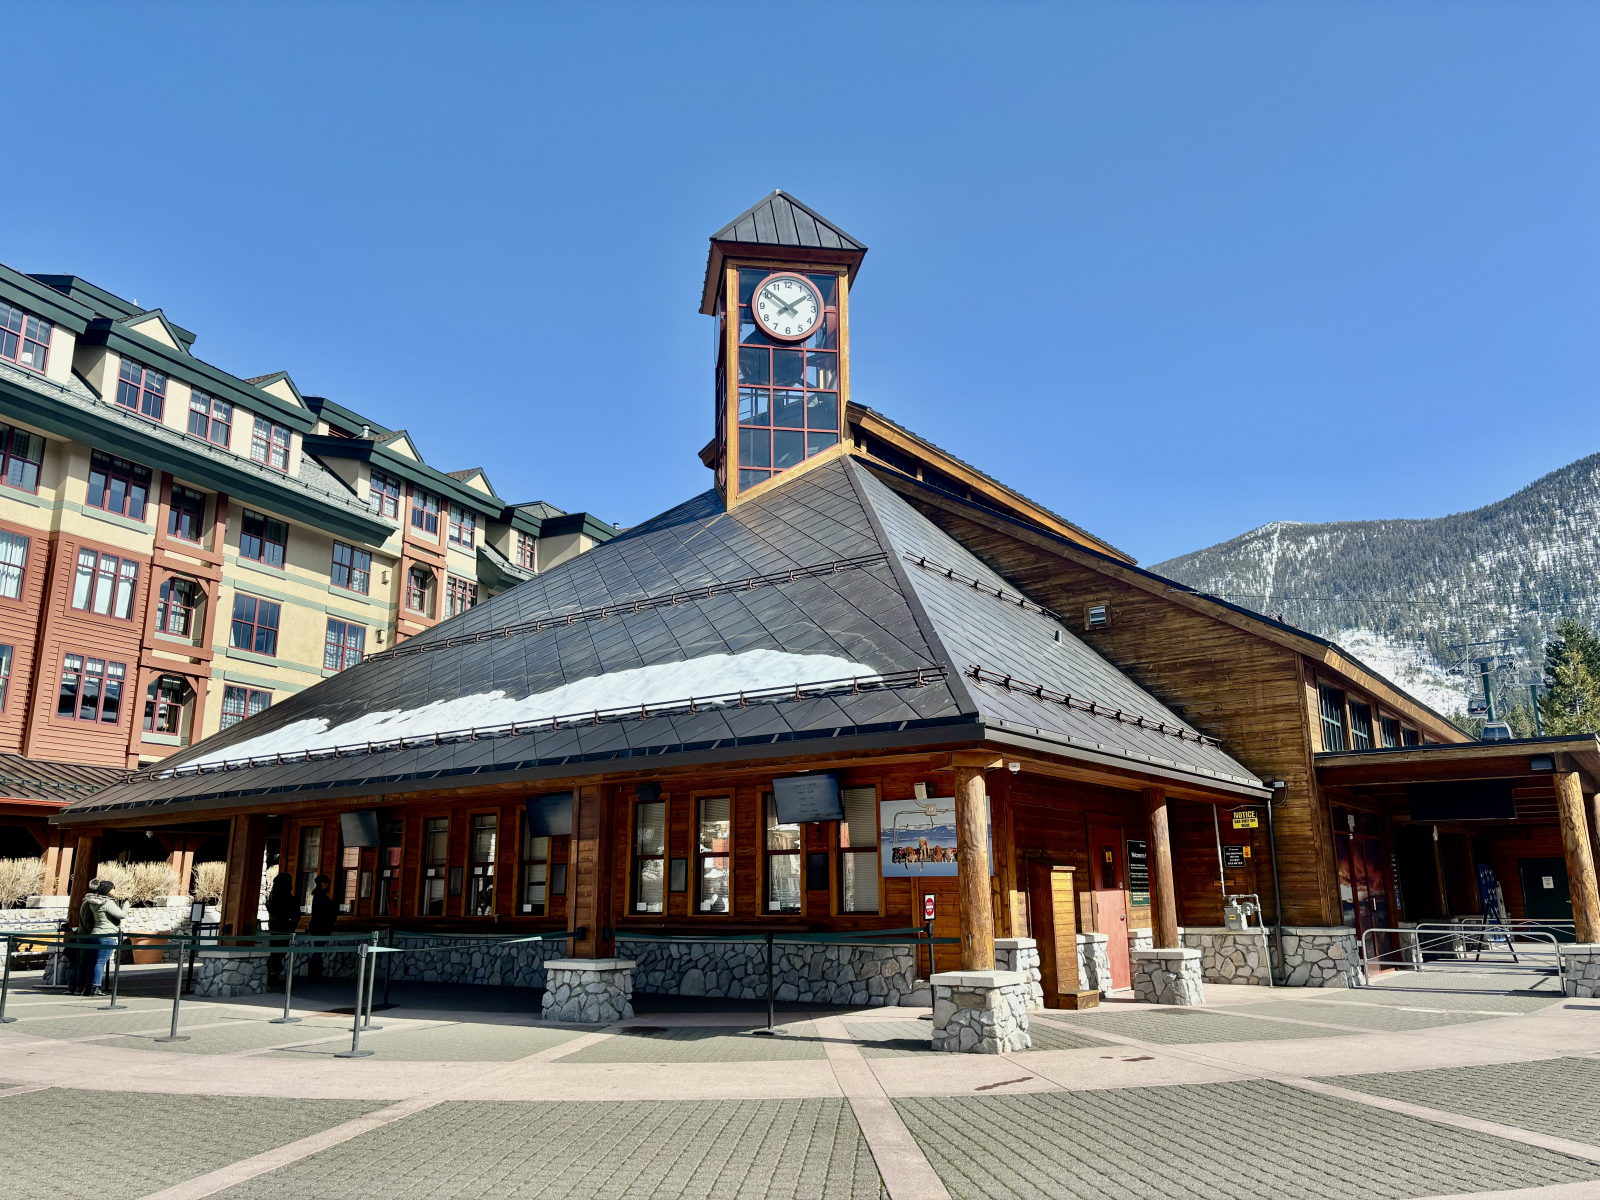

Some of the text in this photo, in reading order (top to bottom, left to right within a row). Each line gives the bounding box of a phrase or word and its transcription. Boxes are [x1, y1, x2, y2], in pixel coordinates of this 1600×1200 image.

[784, 281, 793, 289] 12
[772, 322, 778, 330] 7
[785, 326, 791, 334] 6
